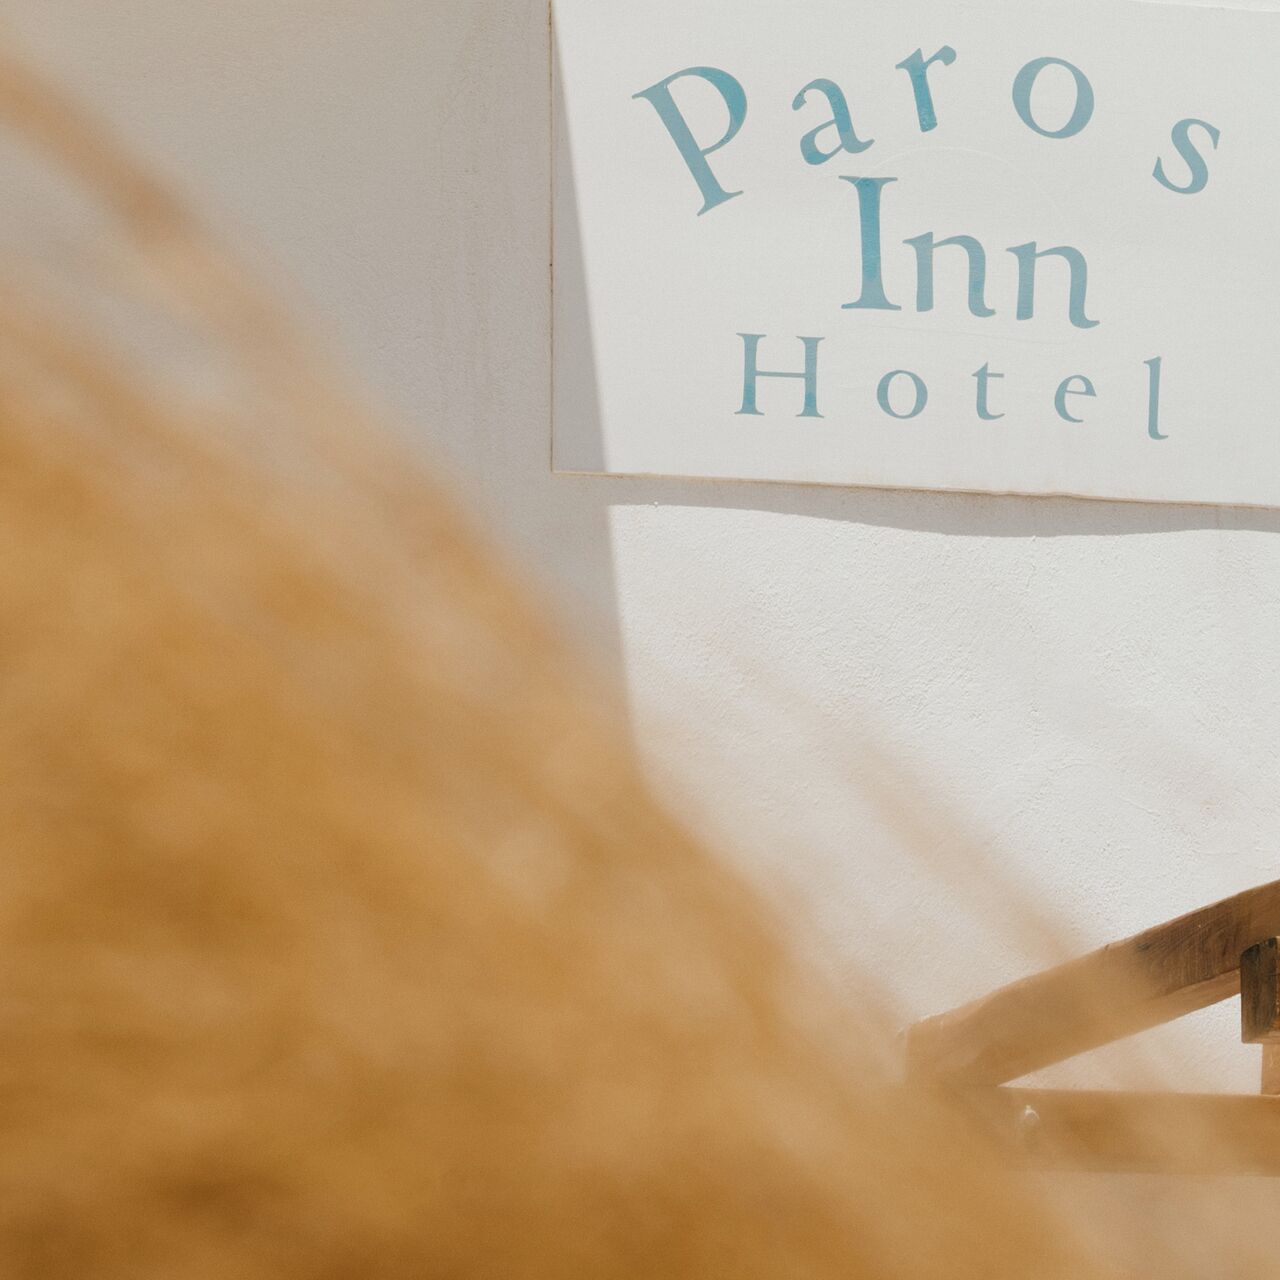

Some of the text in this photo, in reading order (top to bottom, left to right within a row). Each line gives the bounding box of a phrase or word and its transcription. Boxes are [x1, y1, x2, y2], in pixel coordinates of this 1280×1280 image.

[632, 44, 1221, 216] Paros
[838, 175, 1100, 330] Inn
[734, 332, 1169, 441] Hotel
